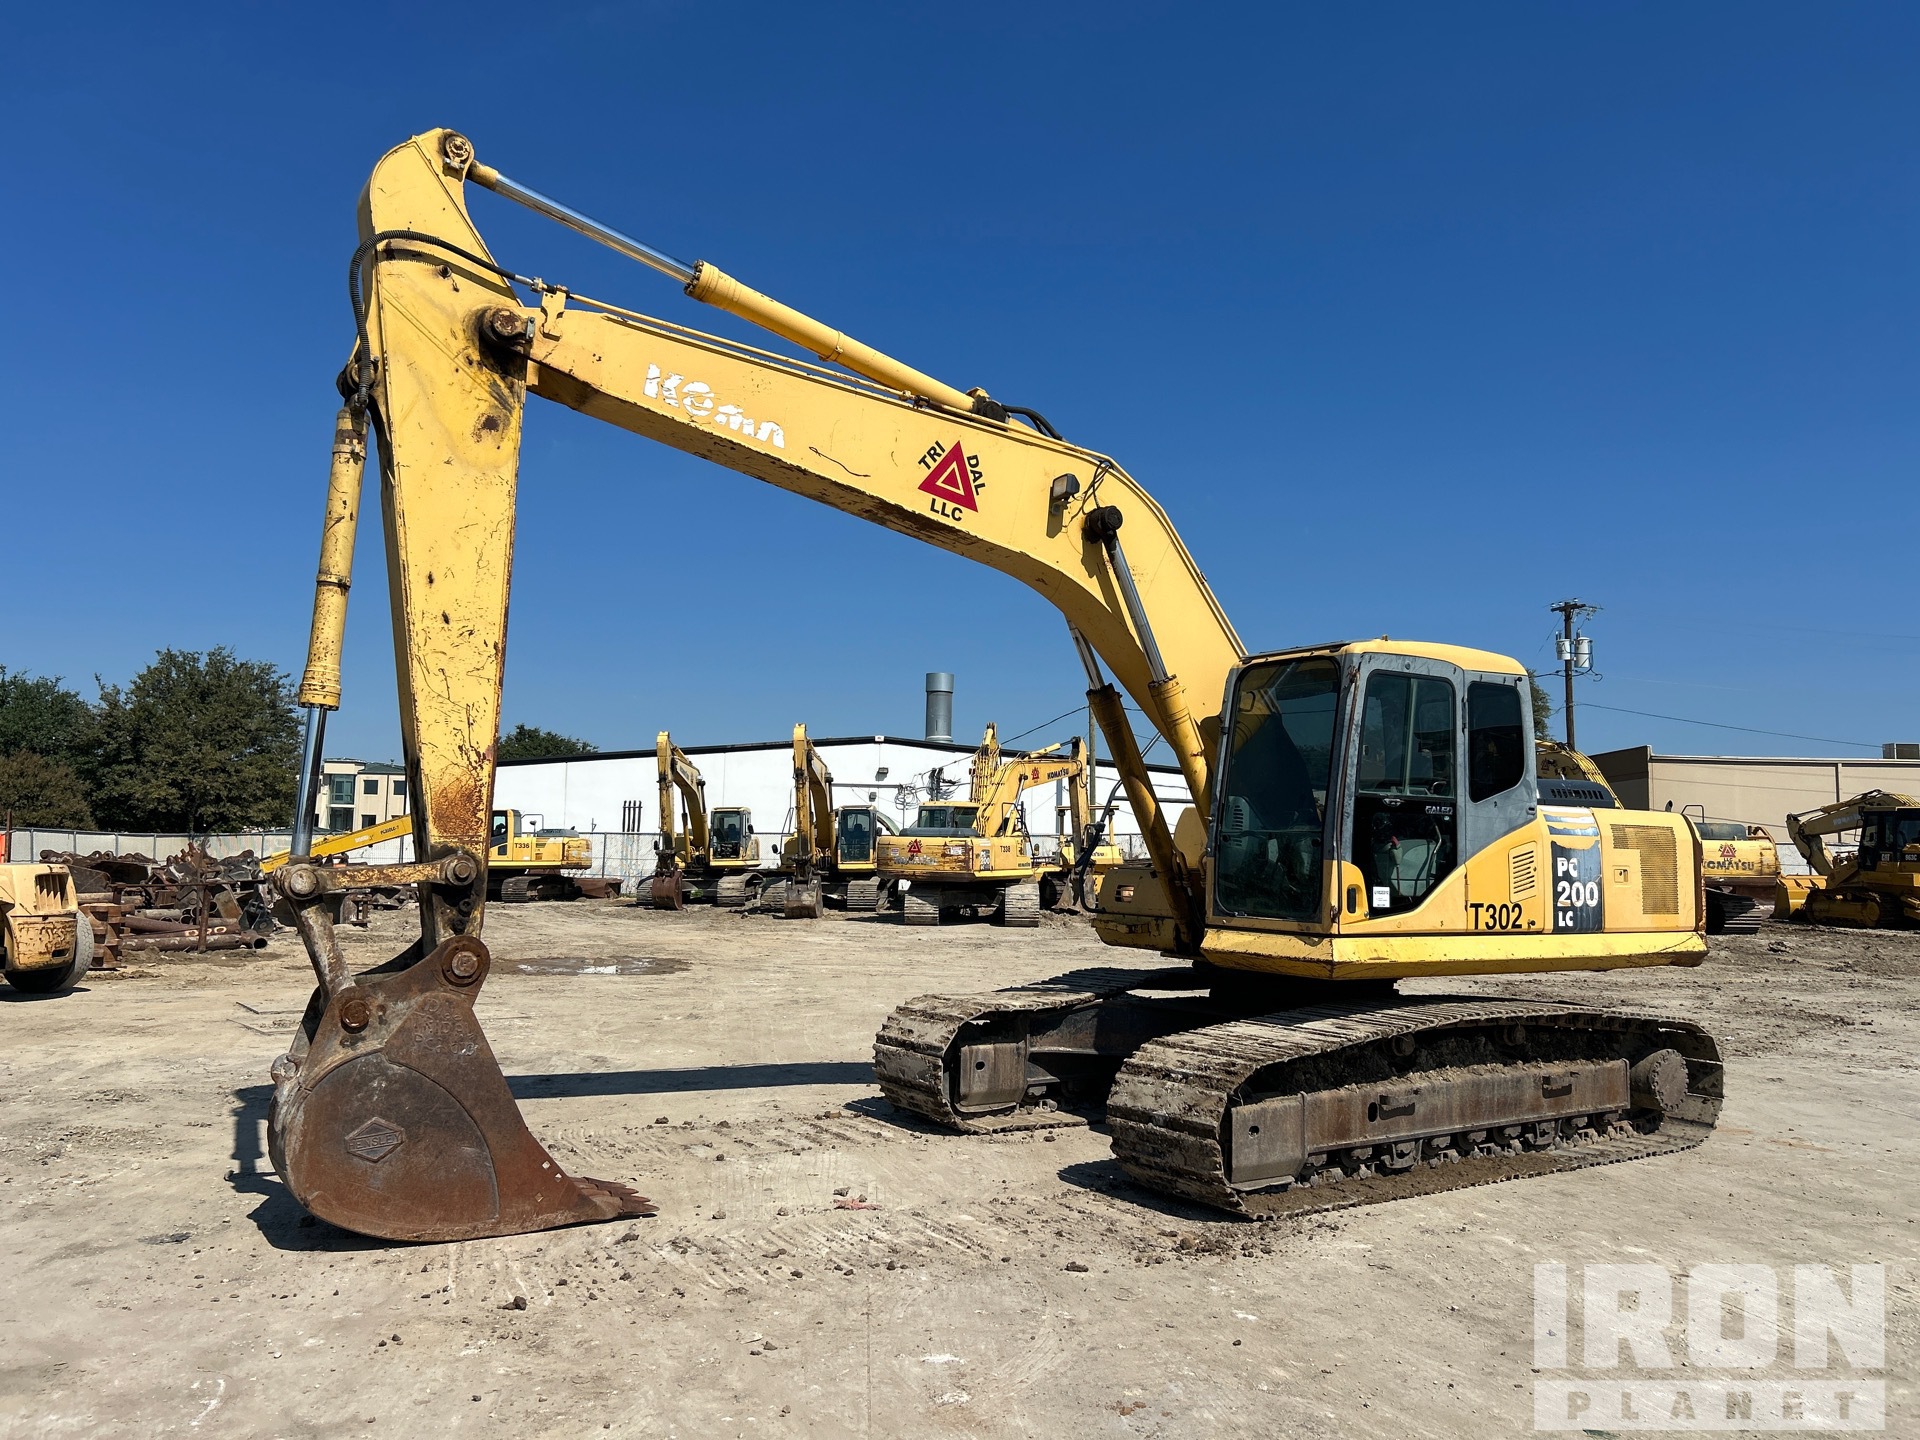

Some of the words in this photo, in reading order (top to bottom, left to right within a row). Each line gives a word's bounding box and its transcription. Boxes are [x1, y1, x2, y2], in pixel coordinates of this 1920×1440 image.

[917, 440, 946, 470] TRI
[966, 454, 986, 496] DAL
[930, 497, 963, 522] LLC
[1046, 767, 1070, 780] KOMATSU
[1557, 857, 1578, 877] PC
[1556, 880, 1599, 907] 200
[1469, 902, 1523, 931] T302
[1558, 910, 1574, 927] LC
